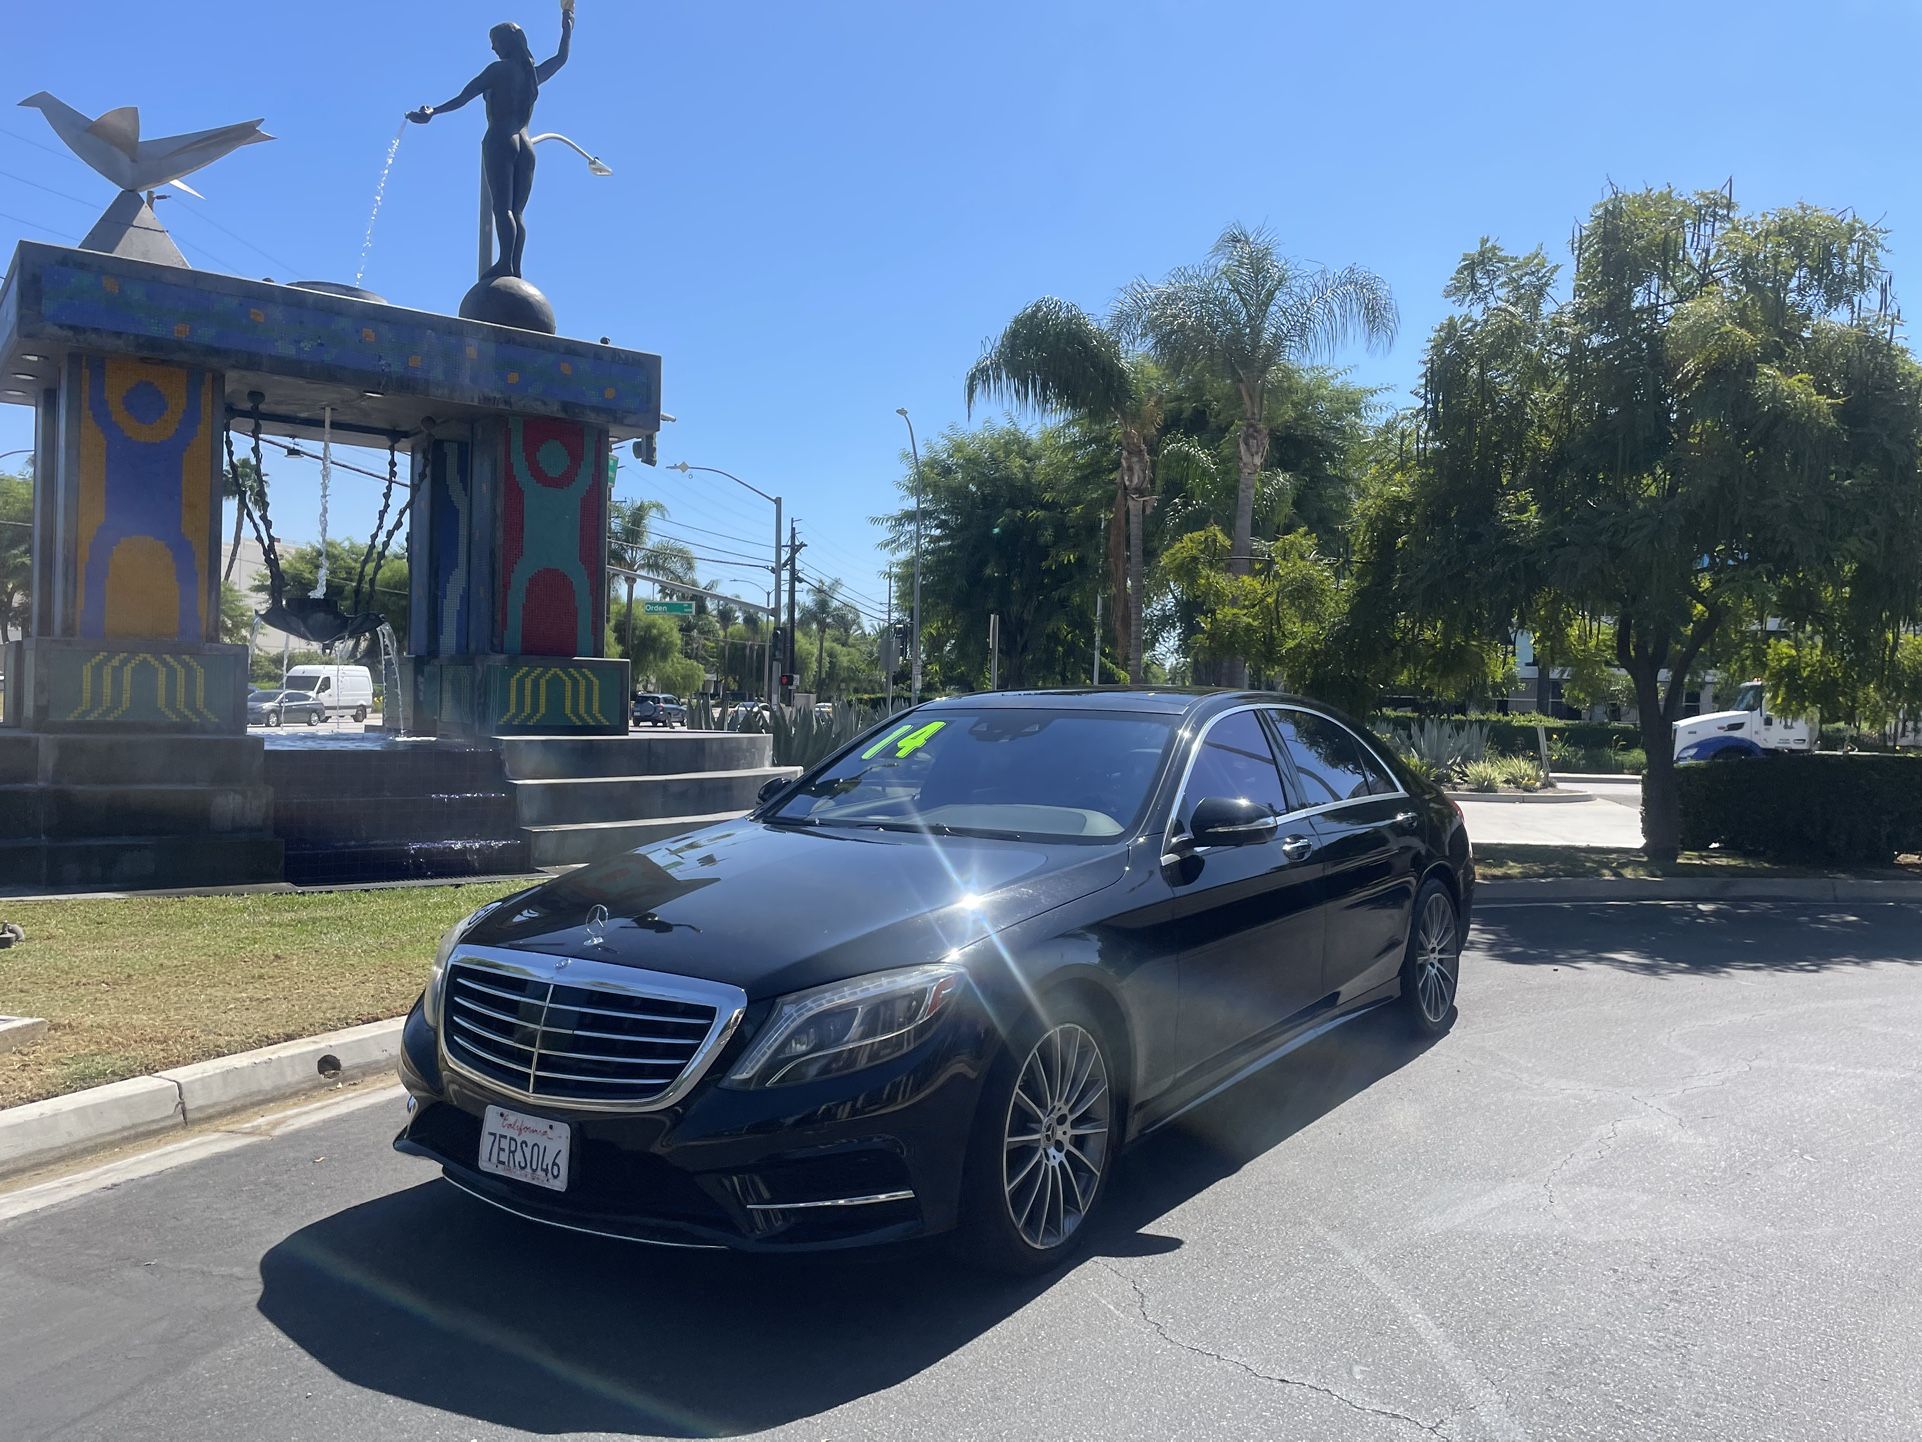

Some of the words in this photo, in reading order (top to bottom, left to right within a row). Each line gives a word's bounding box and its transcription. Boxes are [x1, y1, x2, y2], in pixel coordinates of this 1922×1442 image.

[645, 604, 668, 612] Orden
[861, 721, 947, 760] 14
[501, 1114, 550, 1137] California
[487, 1131, 562, 1180] 7ERS046
